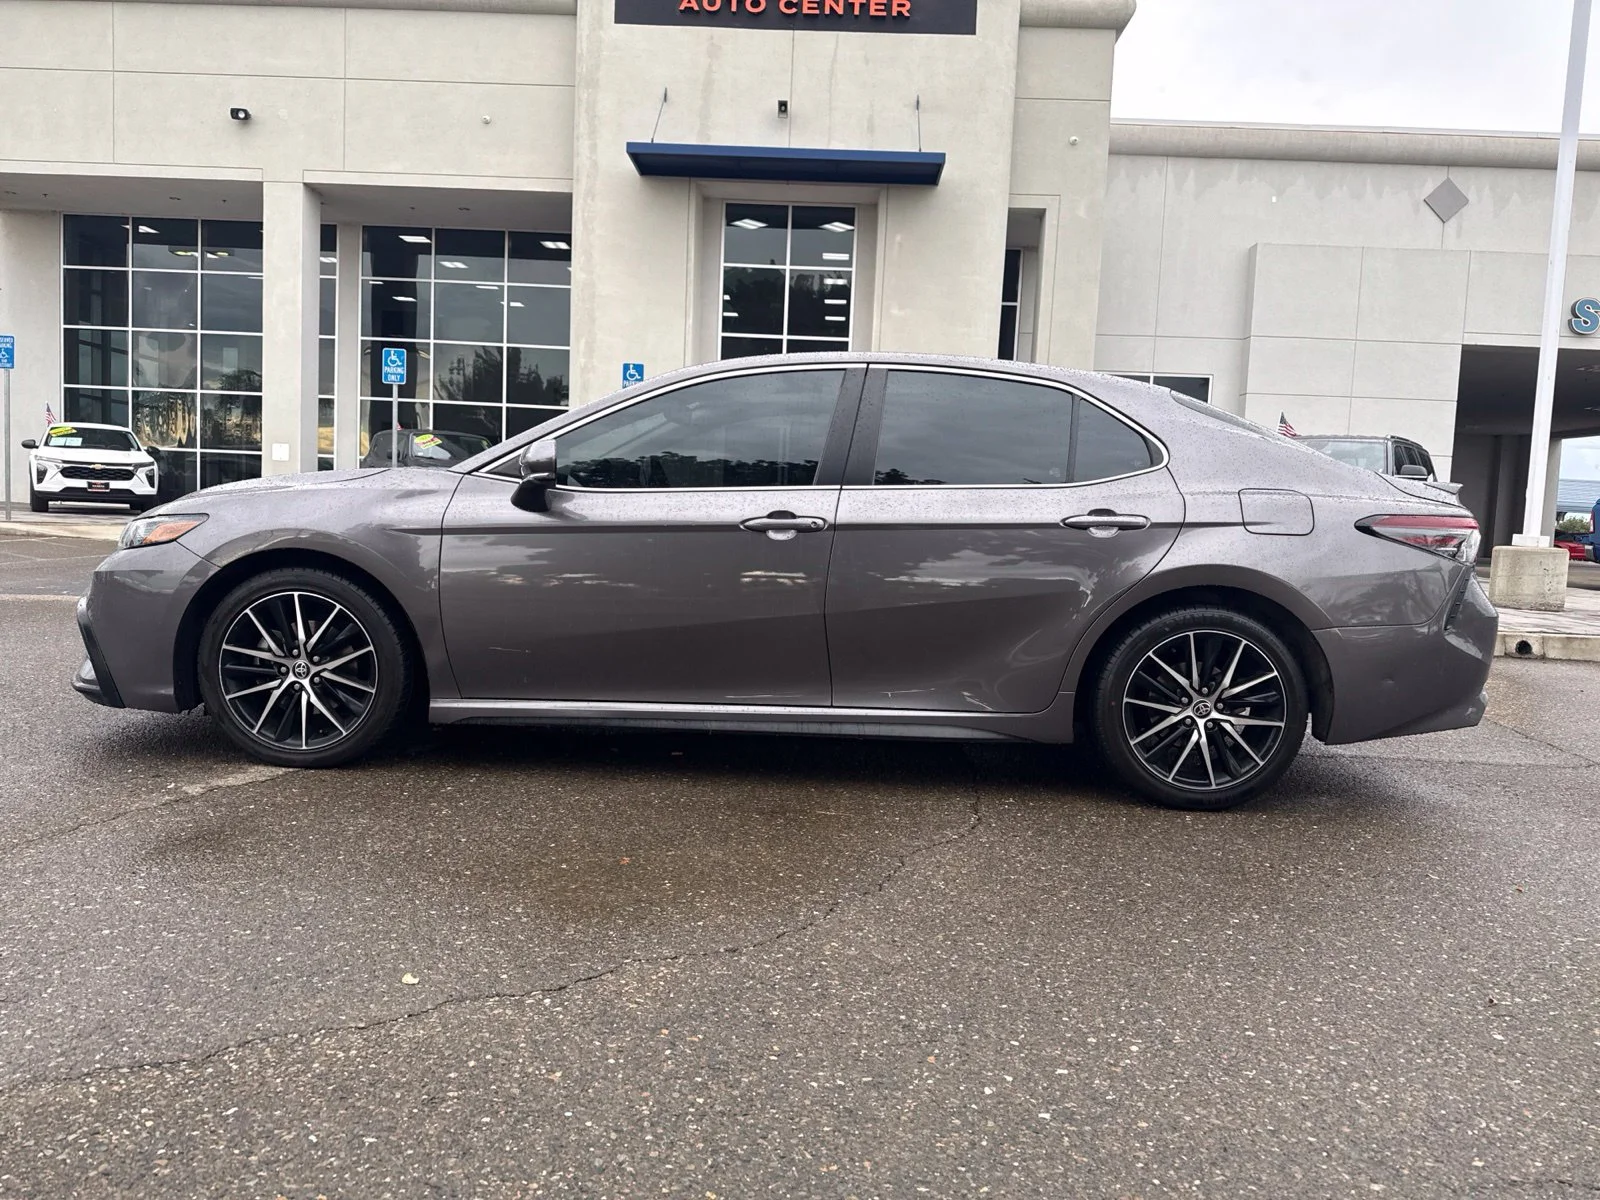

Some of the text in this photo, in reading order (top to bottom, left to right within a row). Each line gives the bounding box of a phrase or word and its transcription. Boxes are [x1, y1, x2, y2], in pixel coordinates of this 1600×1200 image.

[778, 0, 912, 17] CENTER
[384, 366, 404, 374] PARKING
[388, 374, 401, 382] ONLY
